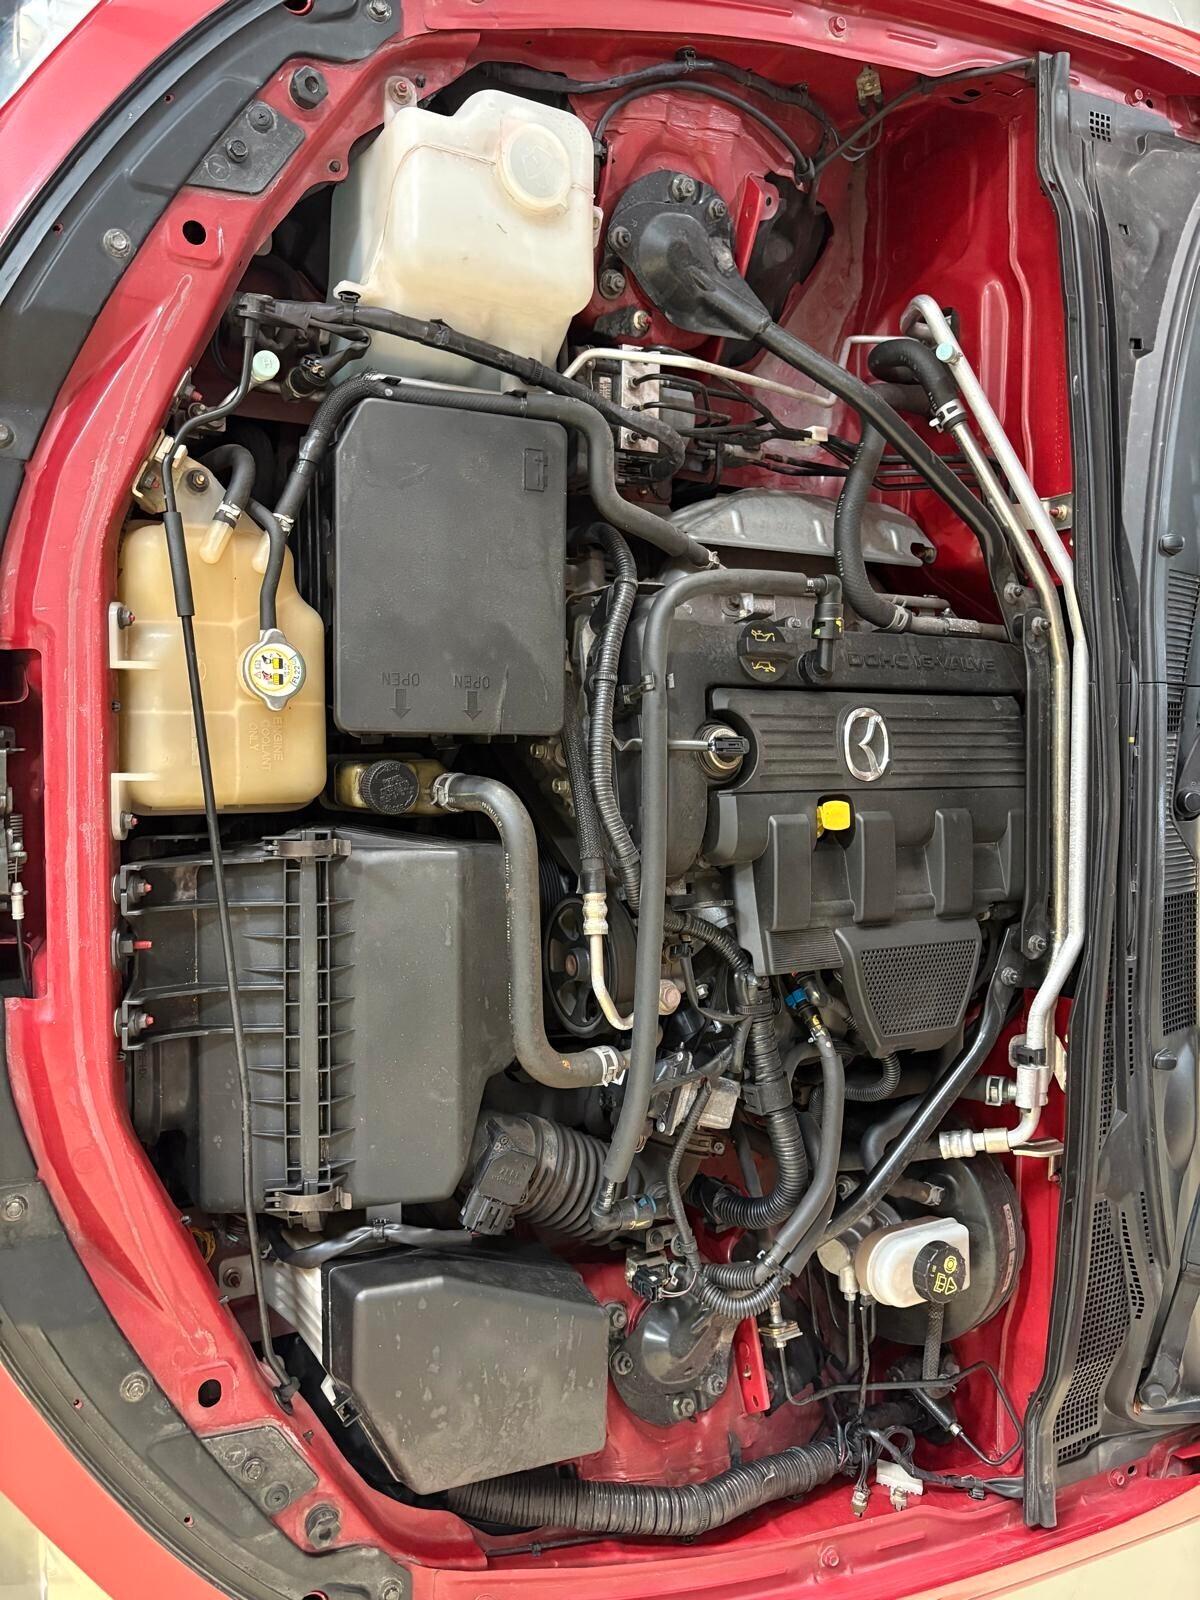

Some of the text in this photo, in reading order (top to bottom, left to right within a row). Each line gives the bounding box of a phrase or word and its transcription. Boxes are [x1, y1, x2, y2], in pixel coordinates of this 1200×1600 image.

[848, 653, 909, 670] DOHC
[291, 664, 301, 684] FL22
[382, 672, 420, 687] OPEN
[454, 675, 490, 689] OPEN
[248, 722, 259, 751] ONLY
[261, 720, 272, 770] COOLANT
[273, 716, 284, 761] ENGINE
